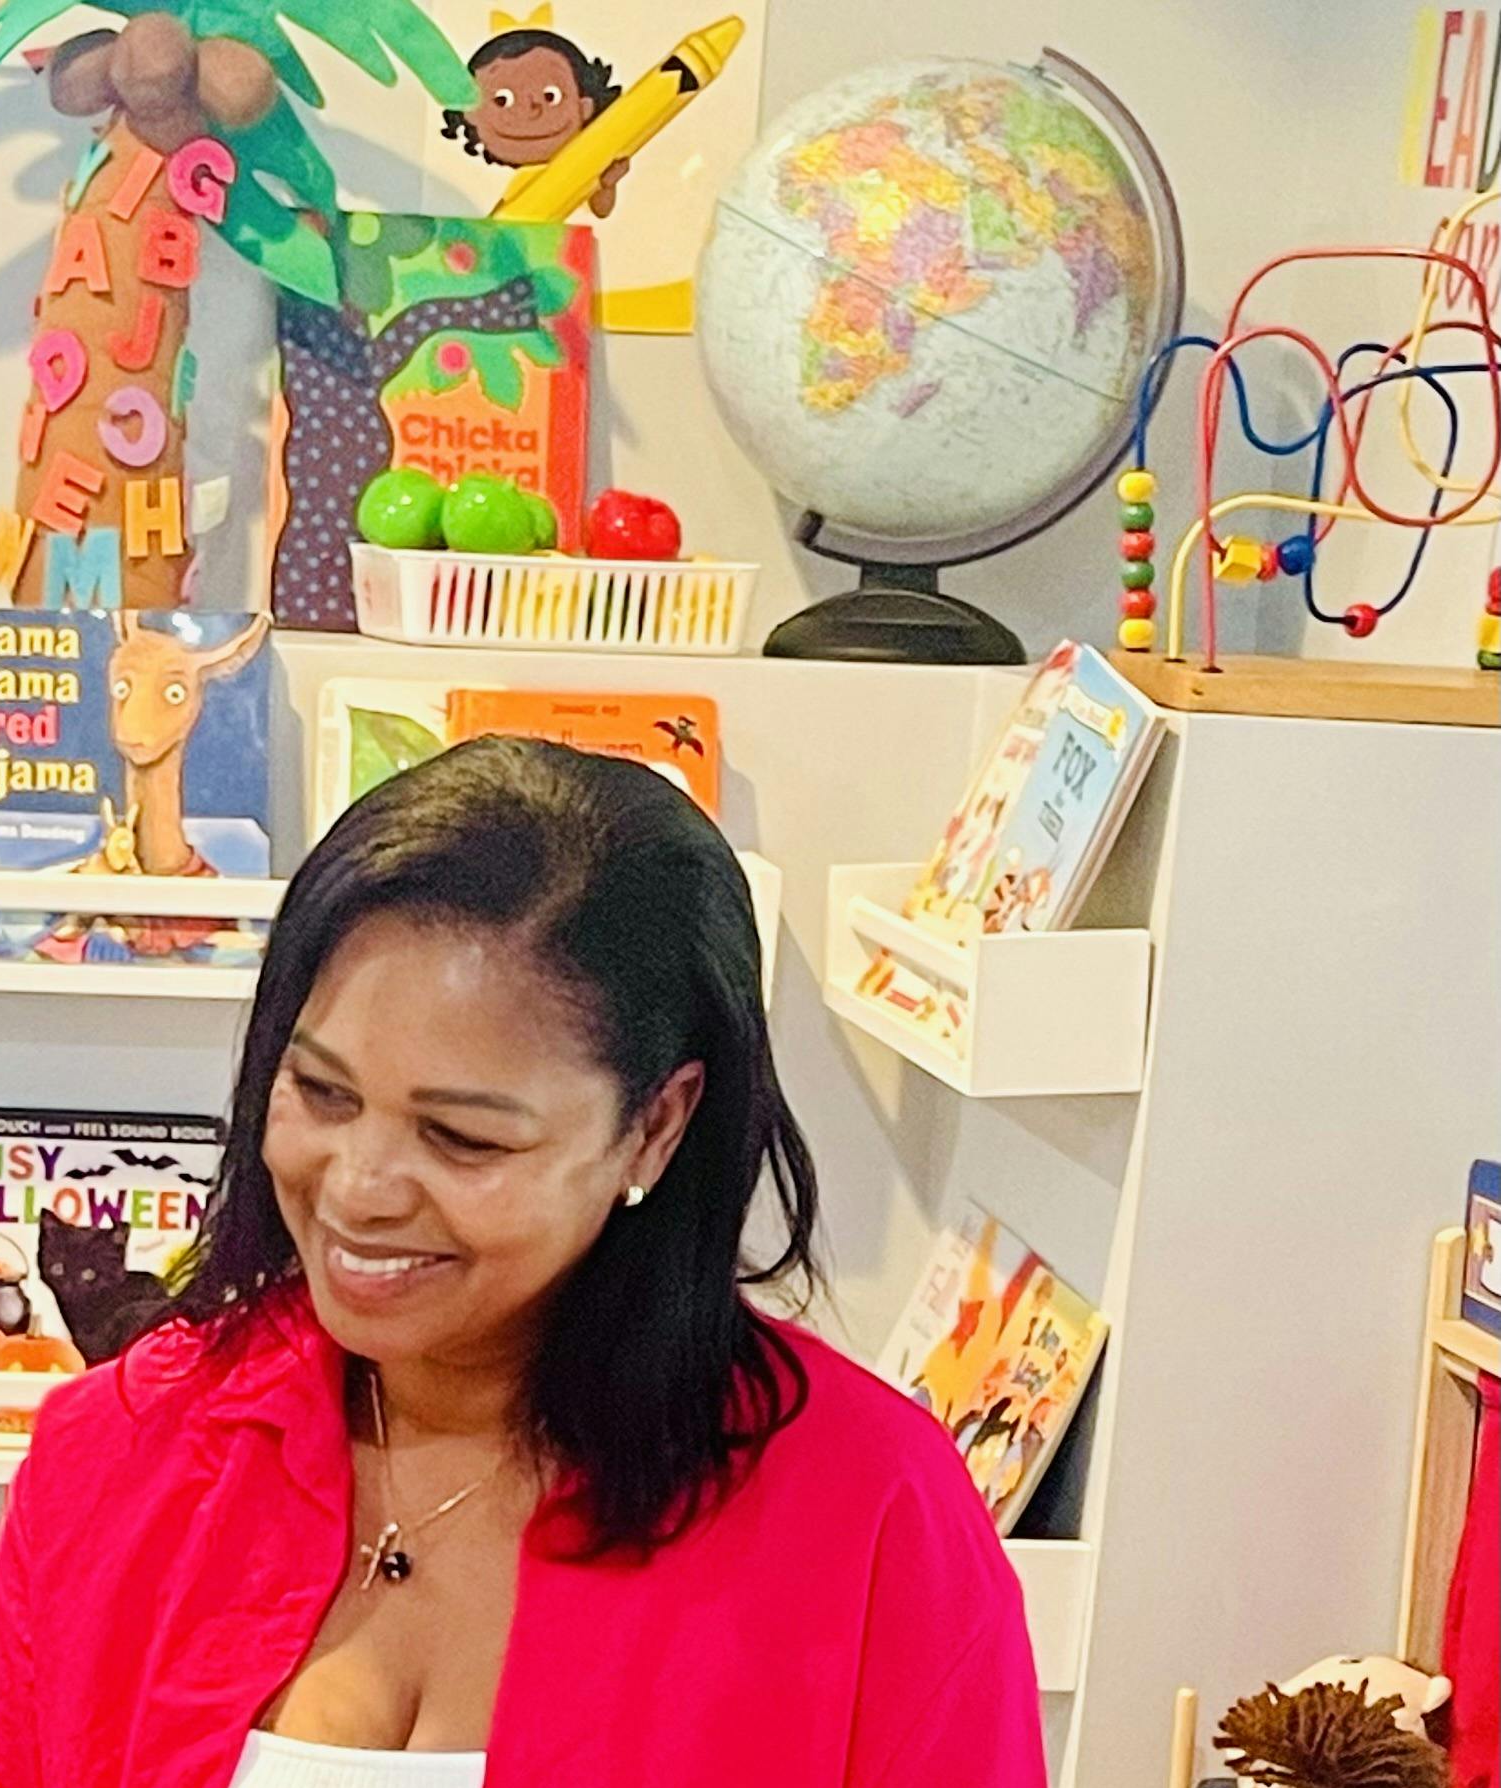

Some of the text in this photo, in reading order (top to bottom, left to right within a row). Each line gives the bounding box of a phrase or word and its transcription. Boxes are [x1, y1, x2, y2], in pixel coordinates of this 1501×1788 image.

[167, 137, 236, 224] G
[47, 215, 110, 294] A
[138, 208, 200, 288] B
[107, 292, 163, 371] J
[399, 413, 538, 454] Chicka
[32, 452, 105, 536] E
[125, 477, 184, 557] H
[45, 528, 122, 608] M
[1052, 731, 1098, 801] FOX
[73, 1121, 107, 1137] FEEL
[110, 1123, 168, 1139] SOUND
[171, 1126, 218, 1140] BOOK
